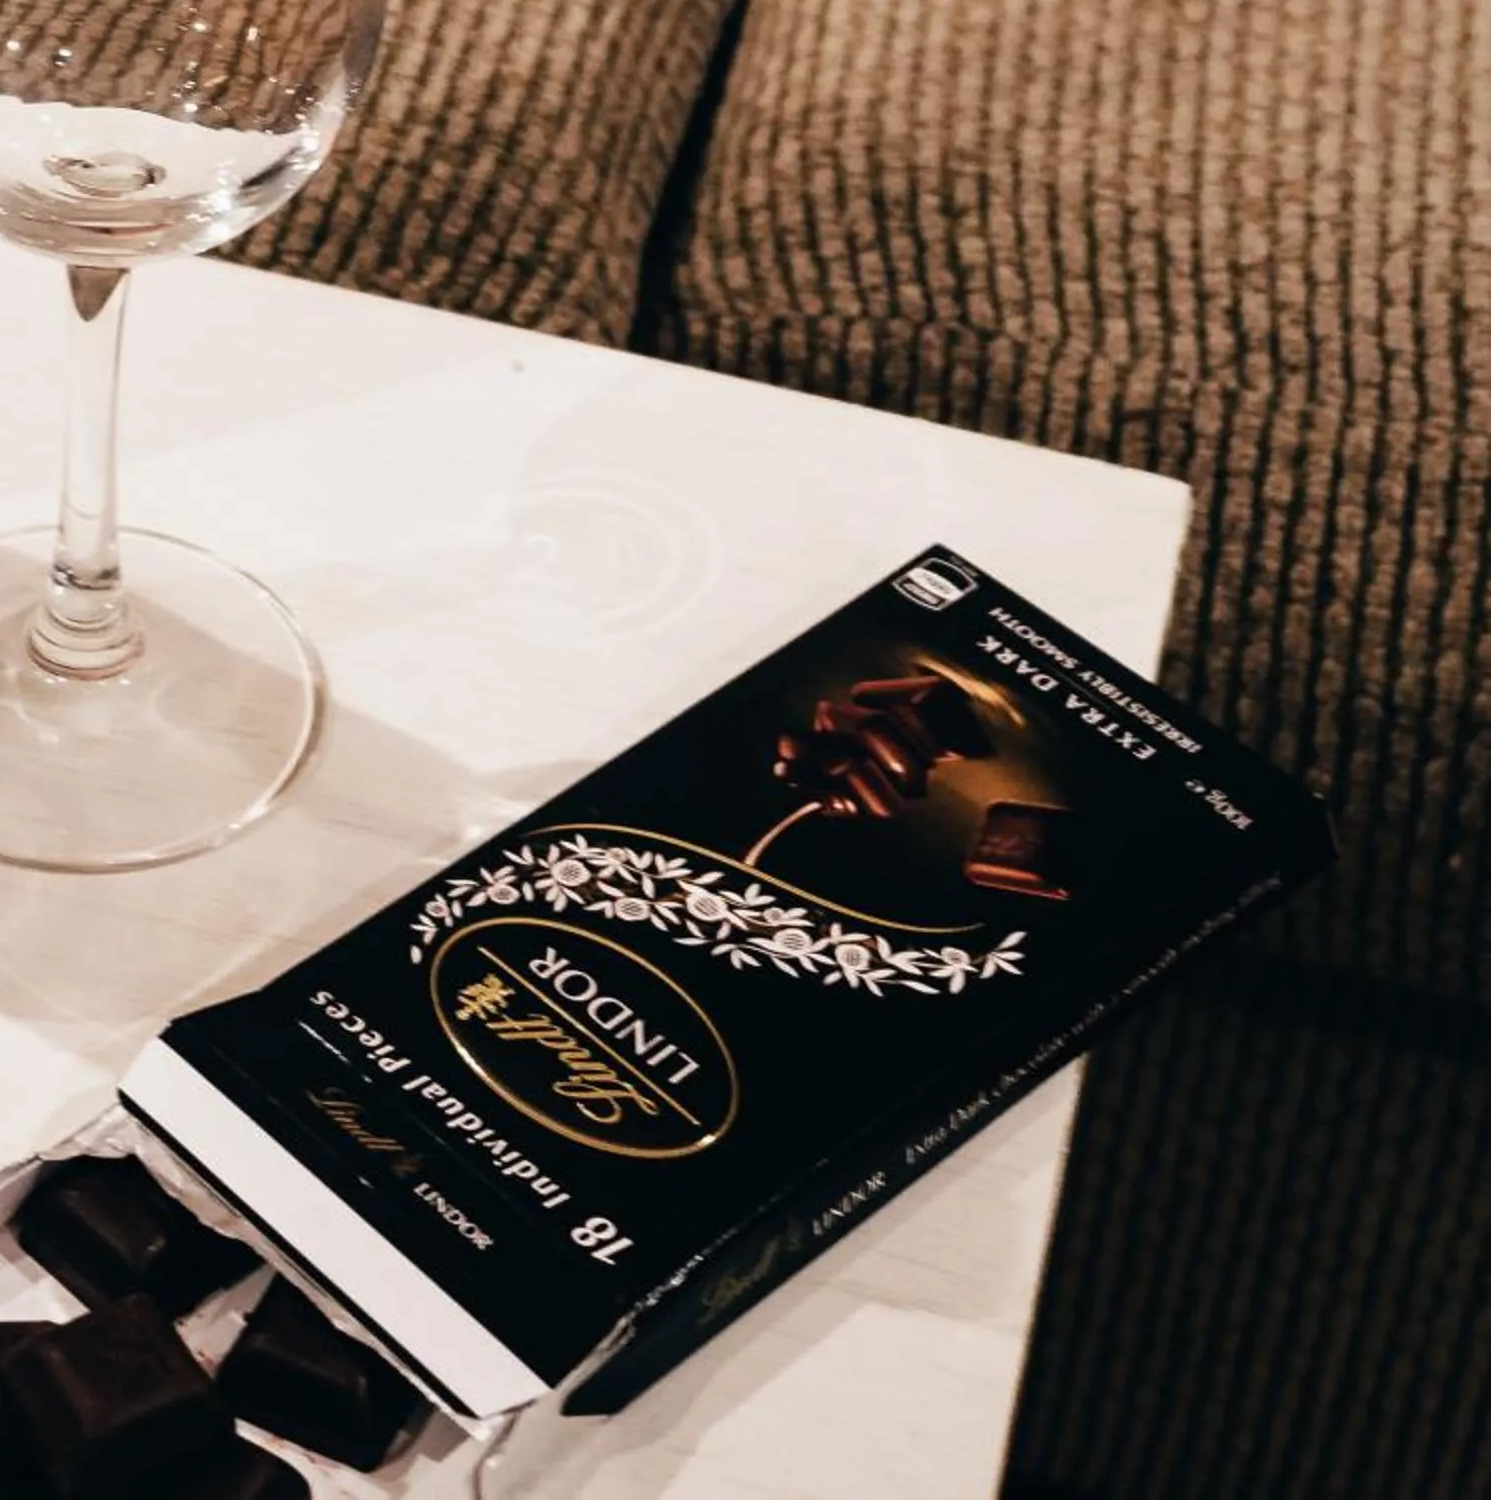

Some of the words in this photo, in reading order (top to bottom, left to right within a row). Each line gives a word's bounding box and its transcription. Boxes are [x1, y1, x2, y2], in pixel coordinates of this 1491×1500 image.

[976, 634, 1060, 693] DARK
[988, 606, 1080, 673] SMOOTH
[1063, 693, 1158, 761] EXTRA
[1077, 668, 1205, 755] IRRESISTIBLY
[309, 990, 411, 1073] Pieces
[527, 946, 700, 1085] LINDOR
[485, 1013, 659, 1124] Lindt
[401, 1074, 572, 1209] Individual
[413, 1182, 494, 1250] LINDOR
[570, 1216, 634, 1266] 18
